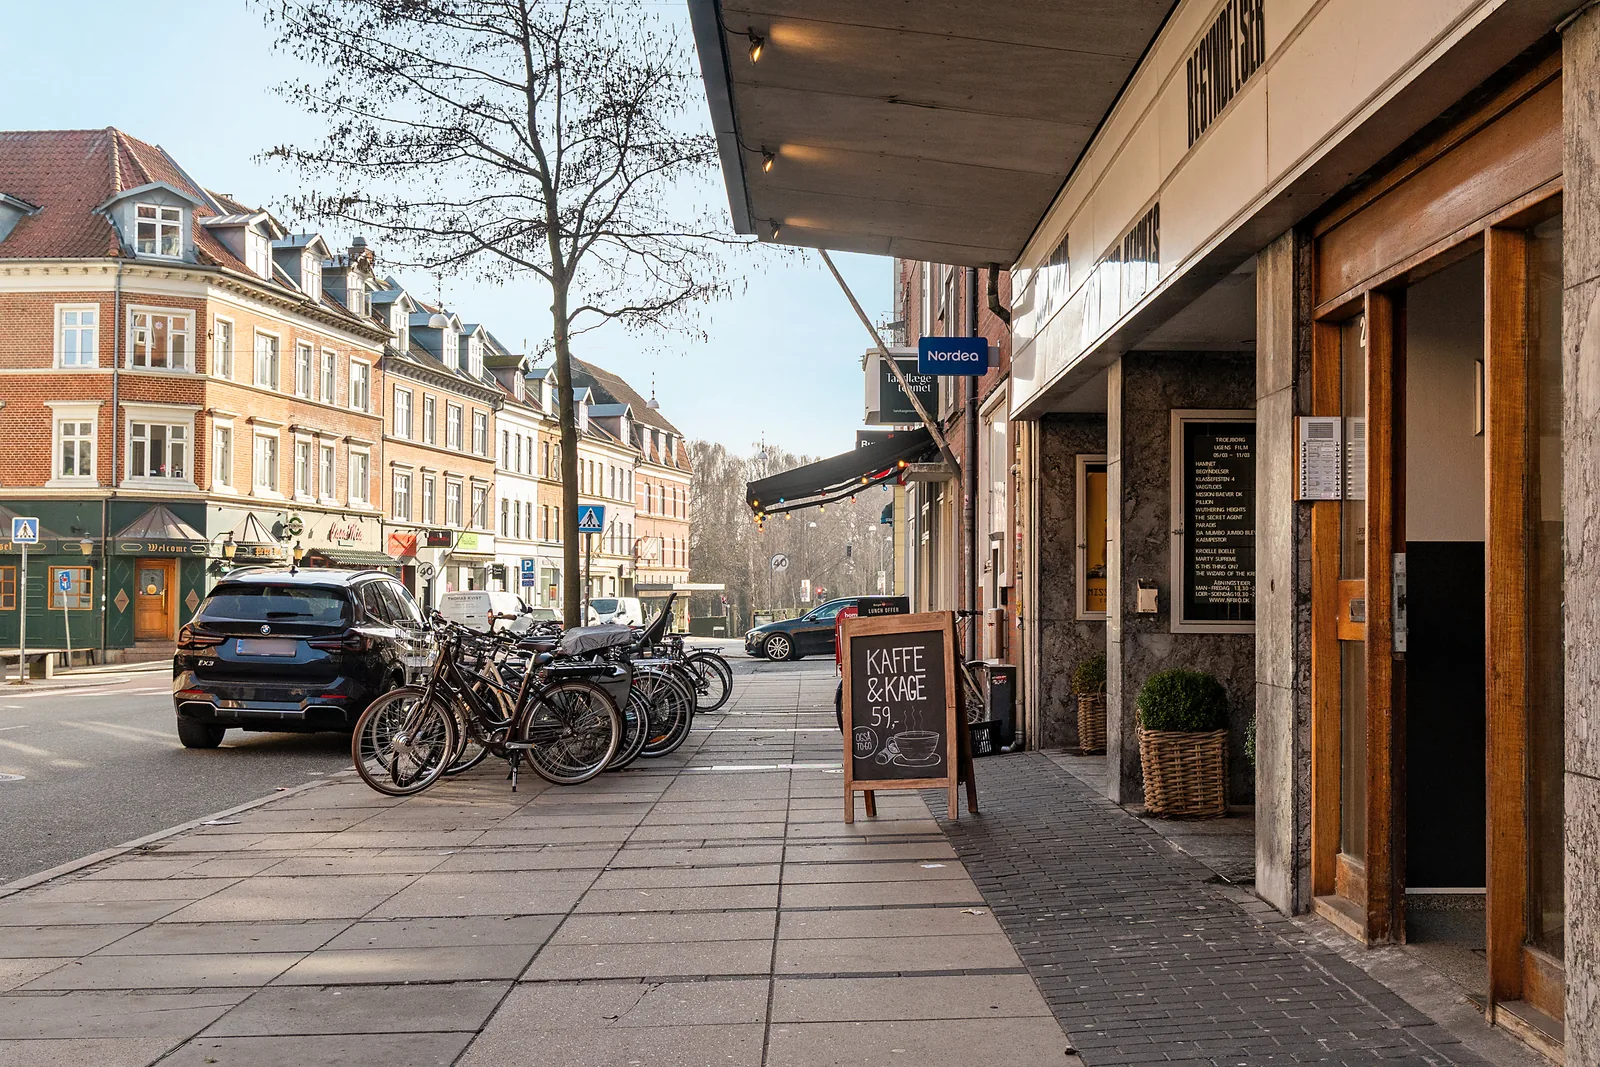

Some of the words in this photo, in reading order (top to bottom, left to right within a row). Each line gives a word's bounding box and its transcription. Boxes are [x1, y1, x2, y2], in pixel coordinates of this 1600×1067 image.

[1187, 0, 1265, 150] BEGYNDELSER
[927, 350, 979, 361] Nordea
[886, 373, 931, 385] Tadlæge
[148, 544, 188, 552] Welcome
[524, 561, 531, 570] P
[772, 558, 787, 567] 40
[420, 567, 432, 577] 40
[866, 646, 926, 675] KAFFE
